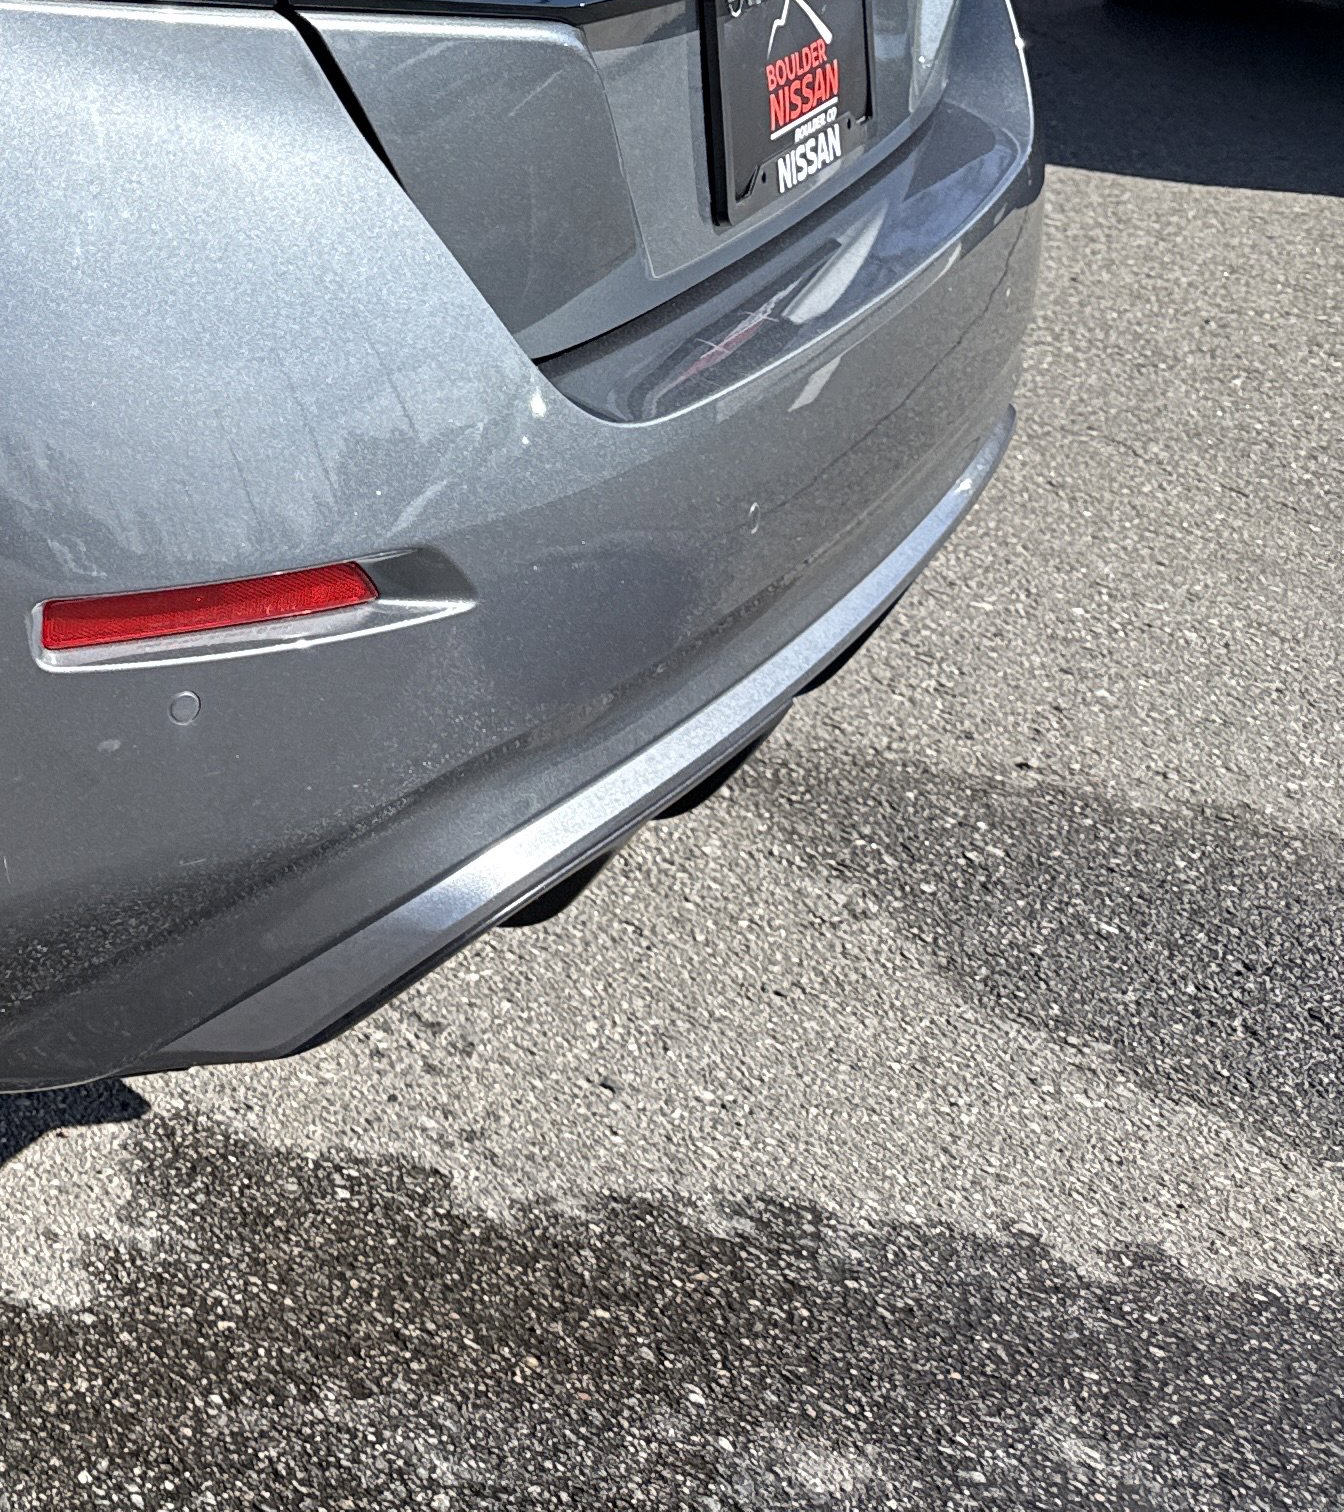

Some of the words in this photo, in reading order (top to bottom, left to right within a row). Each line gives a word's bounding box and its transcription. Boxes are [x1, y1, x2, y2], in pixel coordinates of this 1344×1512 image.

[766, 38, 827, 92] BOULDER
[769, 58, 839, 132] NISSAN
[794, 113, 826, 145] BOULDER
[826, 106, 838, 123] CO
[777, 123, 842, 194] NISSAN
